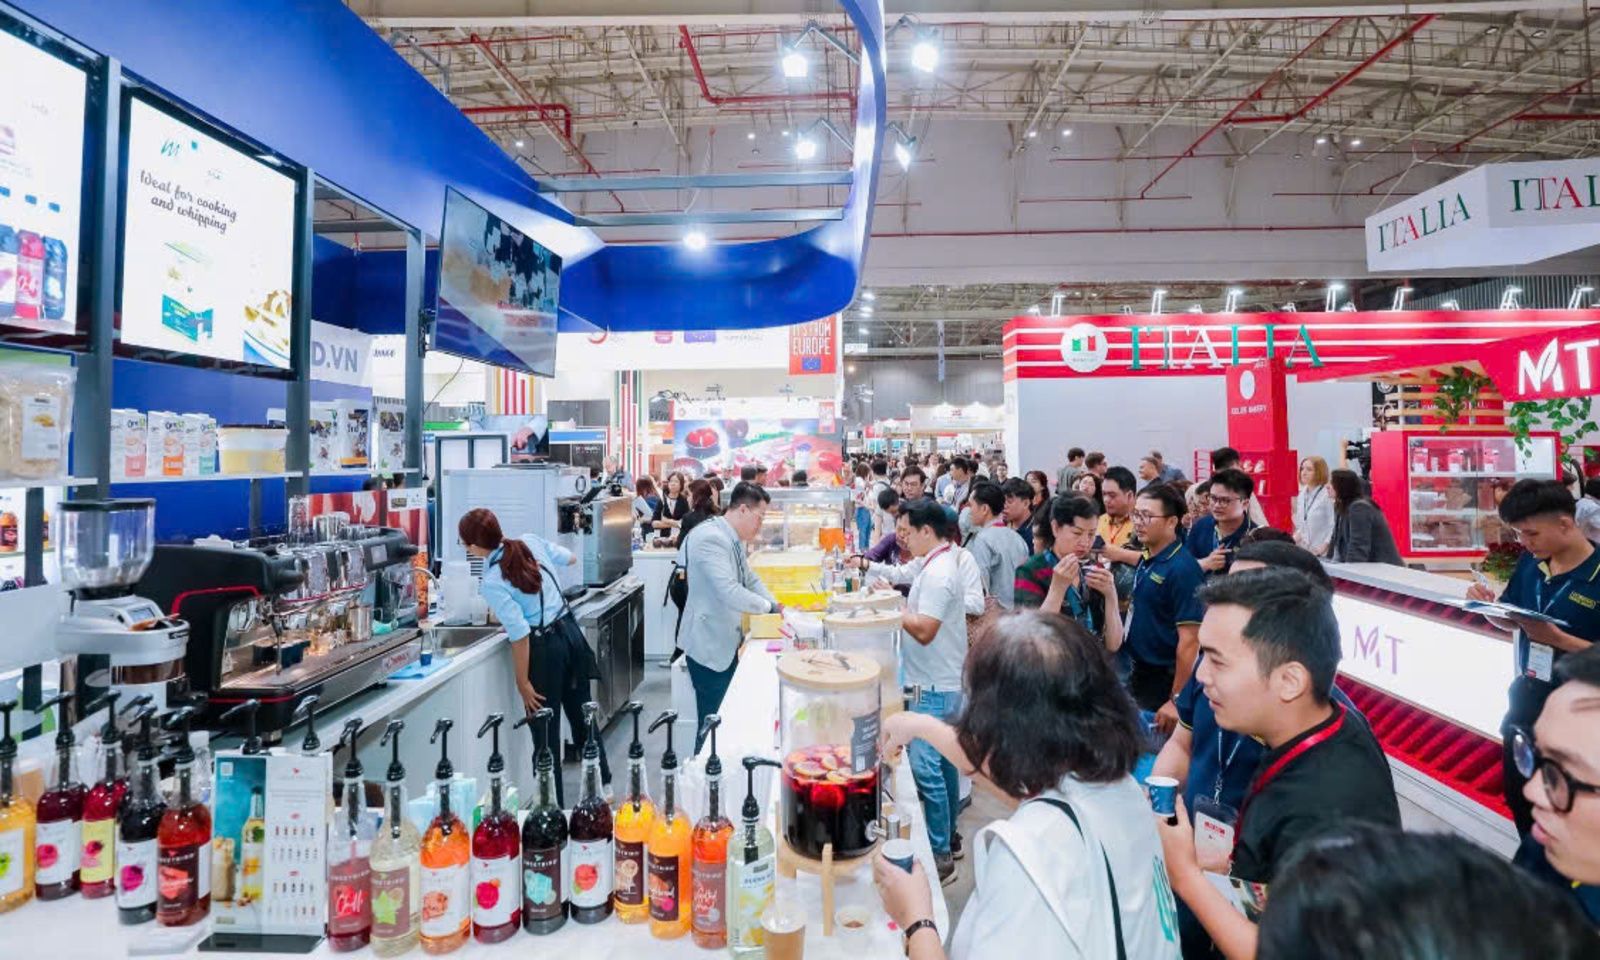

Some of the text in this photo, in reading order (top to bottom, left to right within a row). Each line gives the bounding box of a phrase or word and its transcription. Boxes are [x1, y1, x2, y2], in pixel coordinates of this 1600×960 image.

[140, 169, 237, 223] Ideal for cooking
[151, 194, 227, 235] and whipping
[1378, 192, 1471, 253] ITALIA
[312, 341, 358, 373] D.VN
[793, 336, 831, 355] EUROPE
[1518, 337, 1600, 396] MT
[1353, 625, 1404, 675] MT
